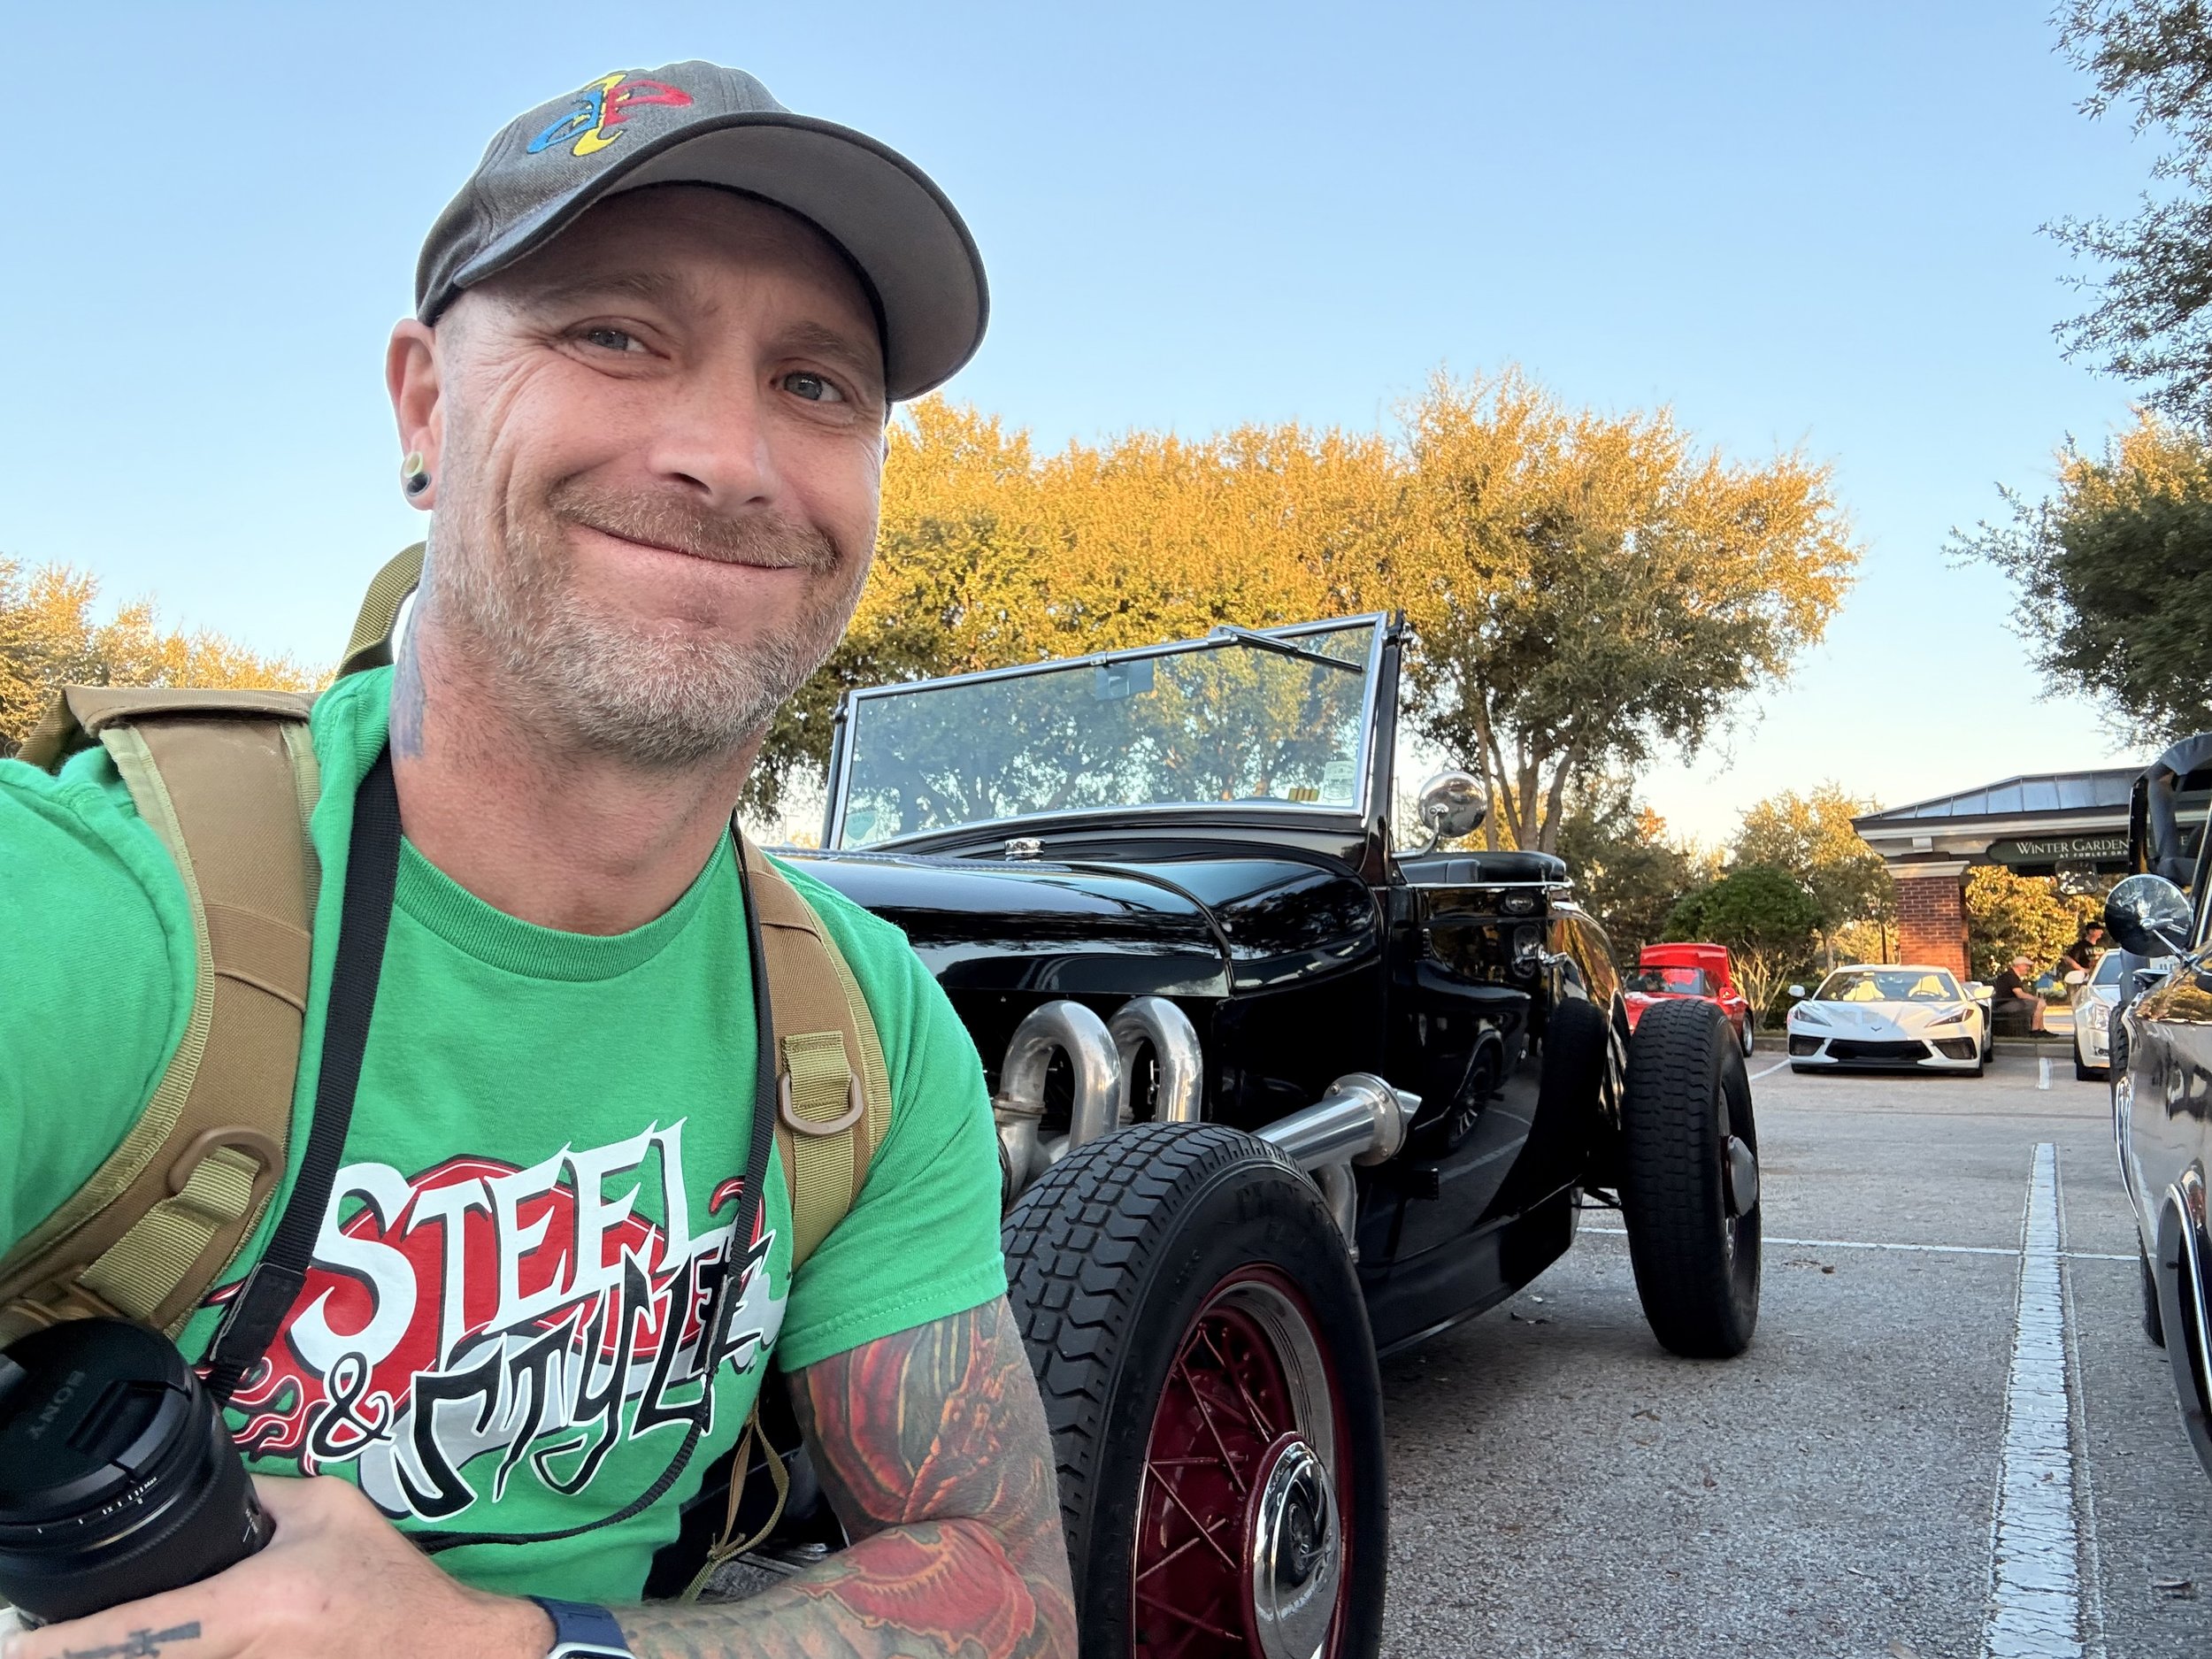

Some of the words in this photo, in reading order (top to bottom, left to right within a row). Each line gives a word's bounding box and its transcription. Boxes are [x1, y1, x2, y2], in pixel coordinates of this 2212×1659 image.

[2016, 841, 2070, 855] WINTER
[2071, 838, 2129, 852] GARDEN
[288, 1116, 738, 1373] STEEL
[28, 1371, 86, 1441] SONY
[304, 1351, 395, 1463] &
